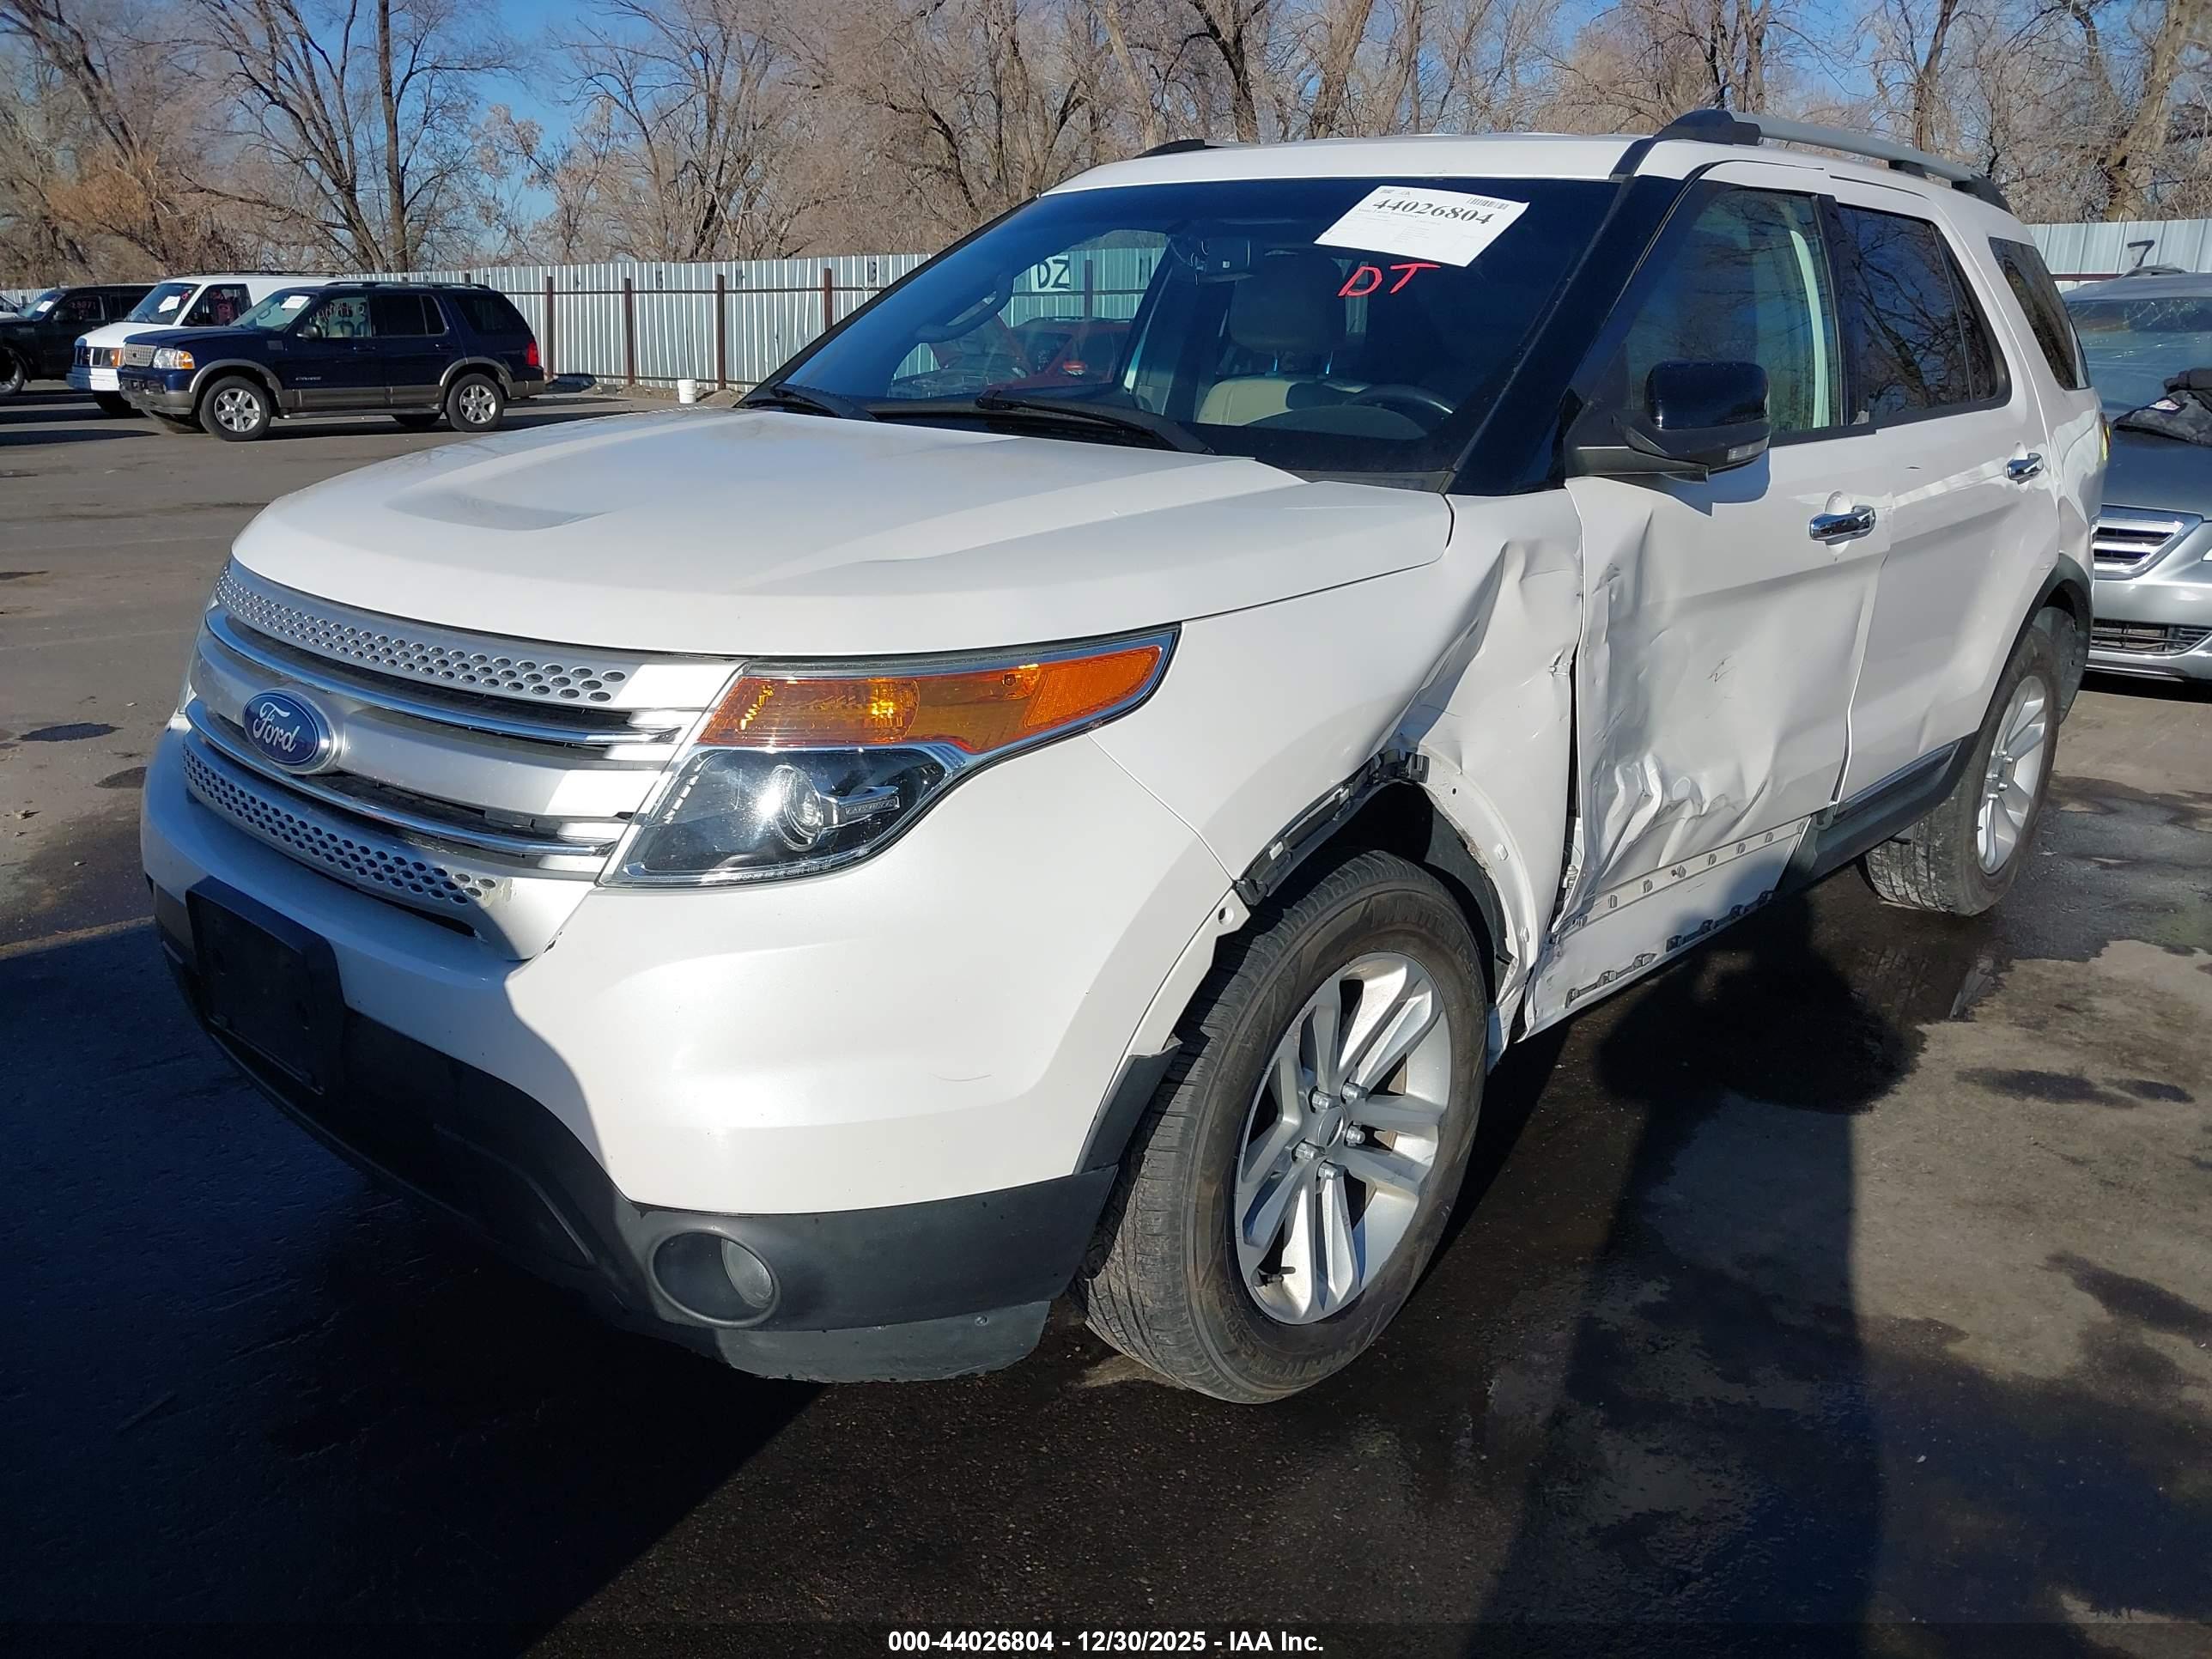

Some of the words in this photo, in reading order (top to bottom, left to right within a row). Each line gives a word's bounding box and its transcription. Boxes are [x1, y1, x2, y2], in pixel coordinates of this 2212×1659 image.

[1372, 198, 1495, 225] 44026804
[1036, 258, 1071, 289] DZ
[1337, 262, 1442, 297] DT
[252, 702, 301, 753] Ford
